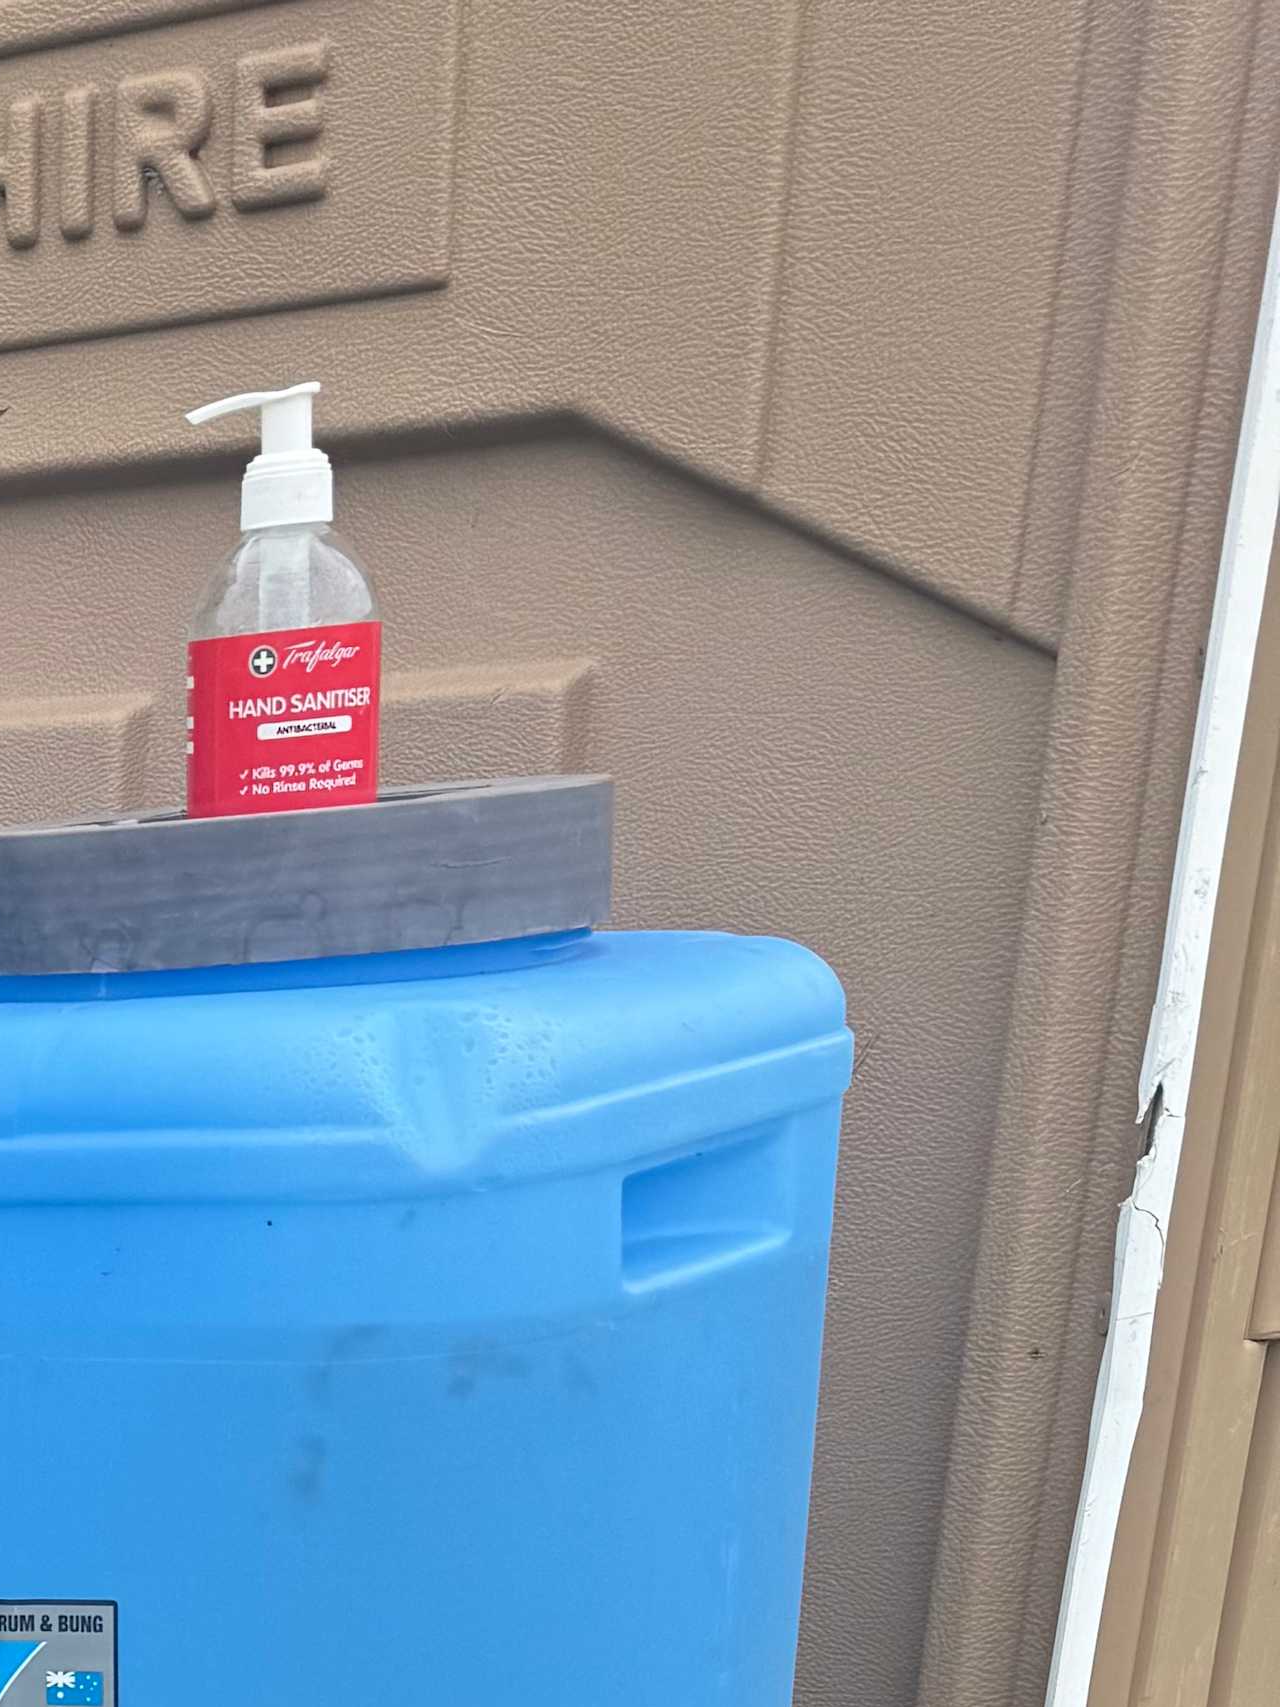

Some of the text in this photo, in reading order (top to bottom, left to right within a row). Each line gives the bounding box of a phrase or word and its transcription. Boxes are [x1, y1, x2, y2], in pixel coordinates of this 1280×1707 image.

[282, 640, 360, 673] Trafalgar
[229, 687, 370, 719] HAND SANITISER
[252, 759, 363, 780] Kills 99.9% of Germs
[252, 772, 356, 795] No Rinse Required
[40, 1615, 52, 1632] &
[58, 1615, 103, 1633] BUNG
